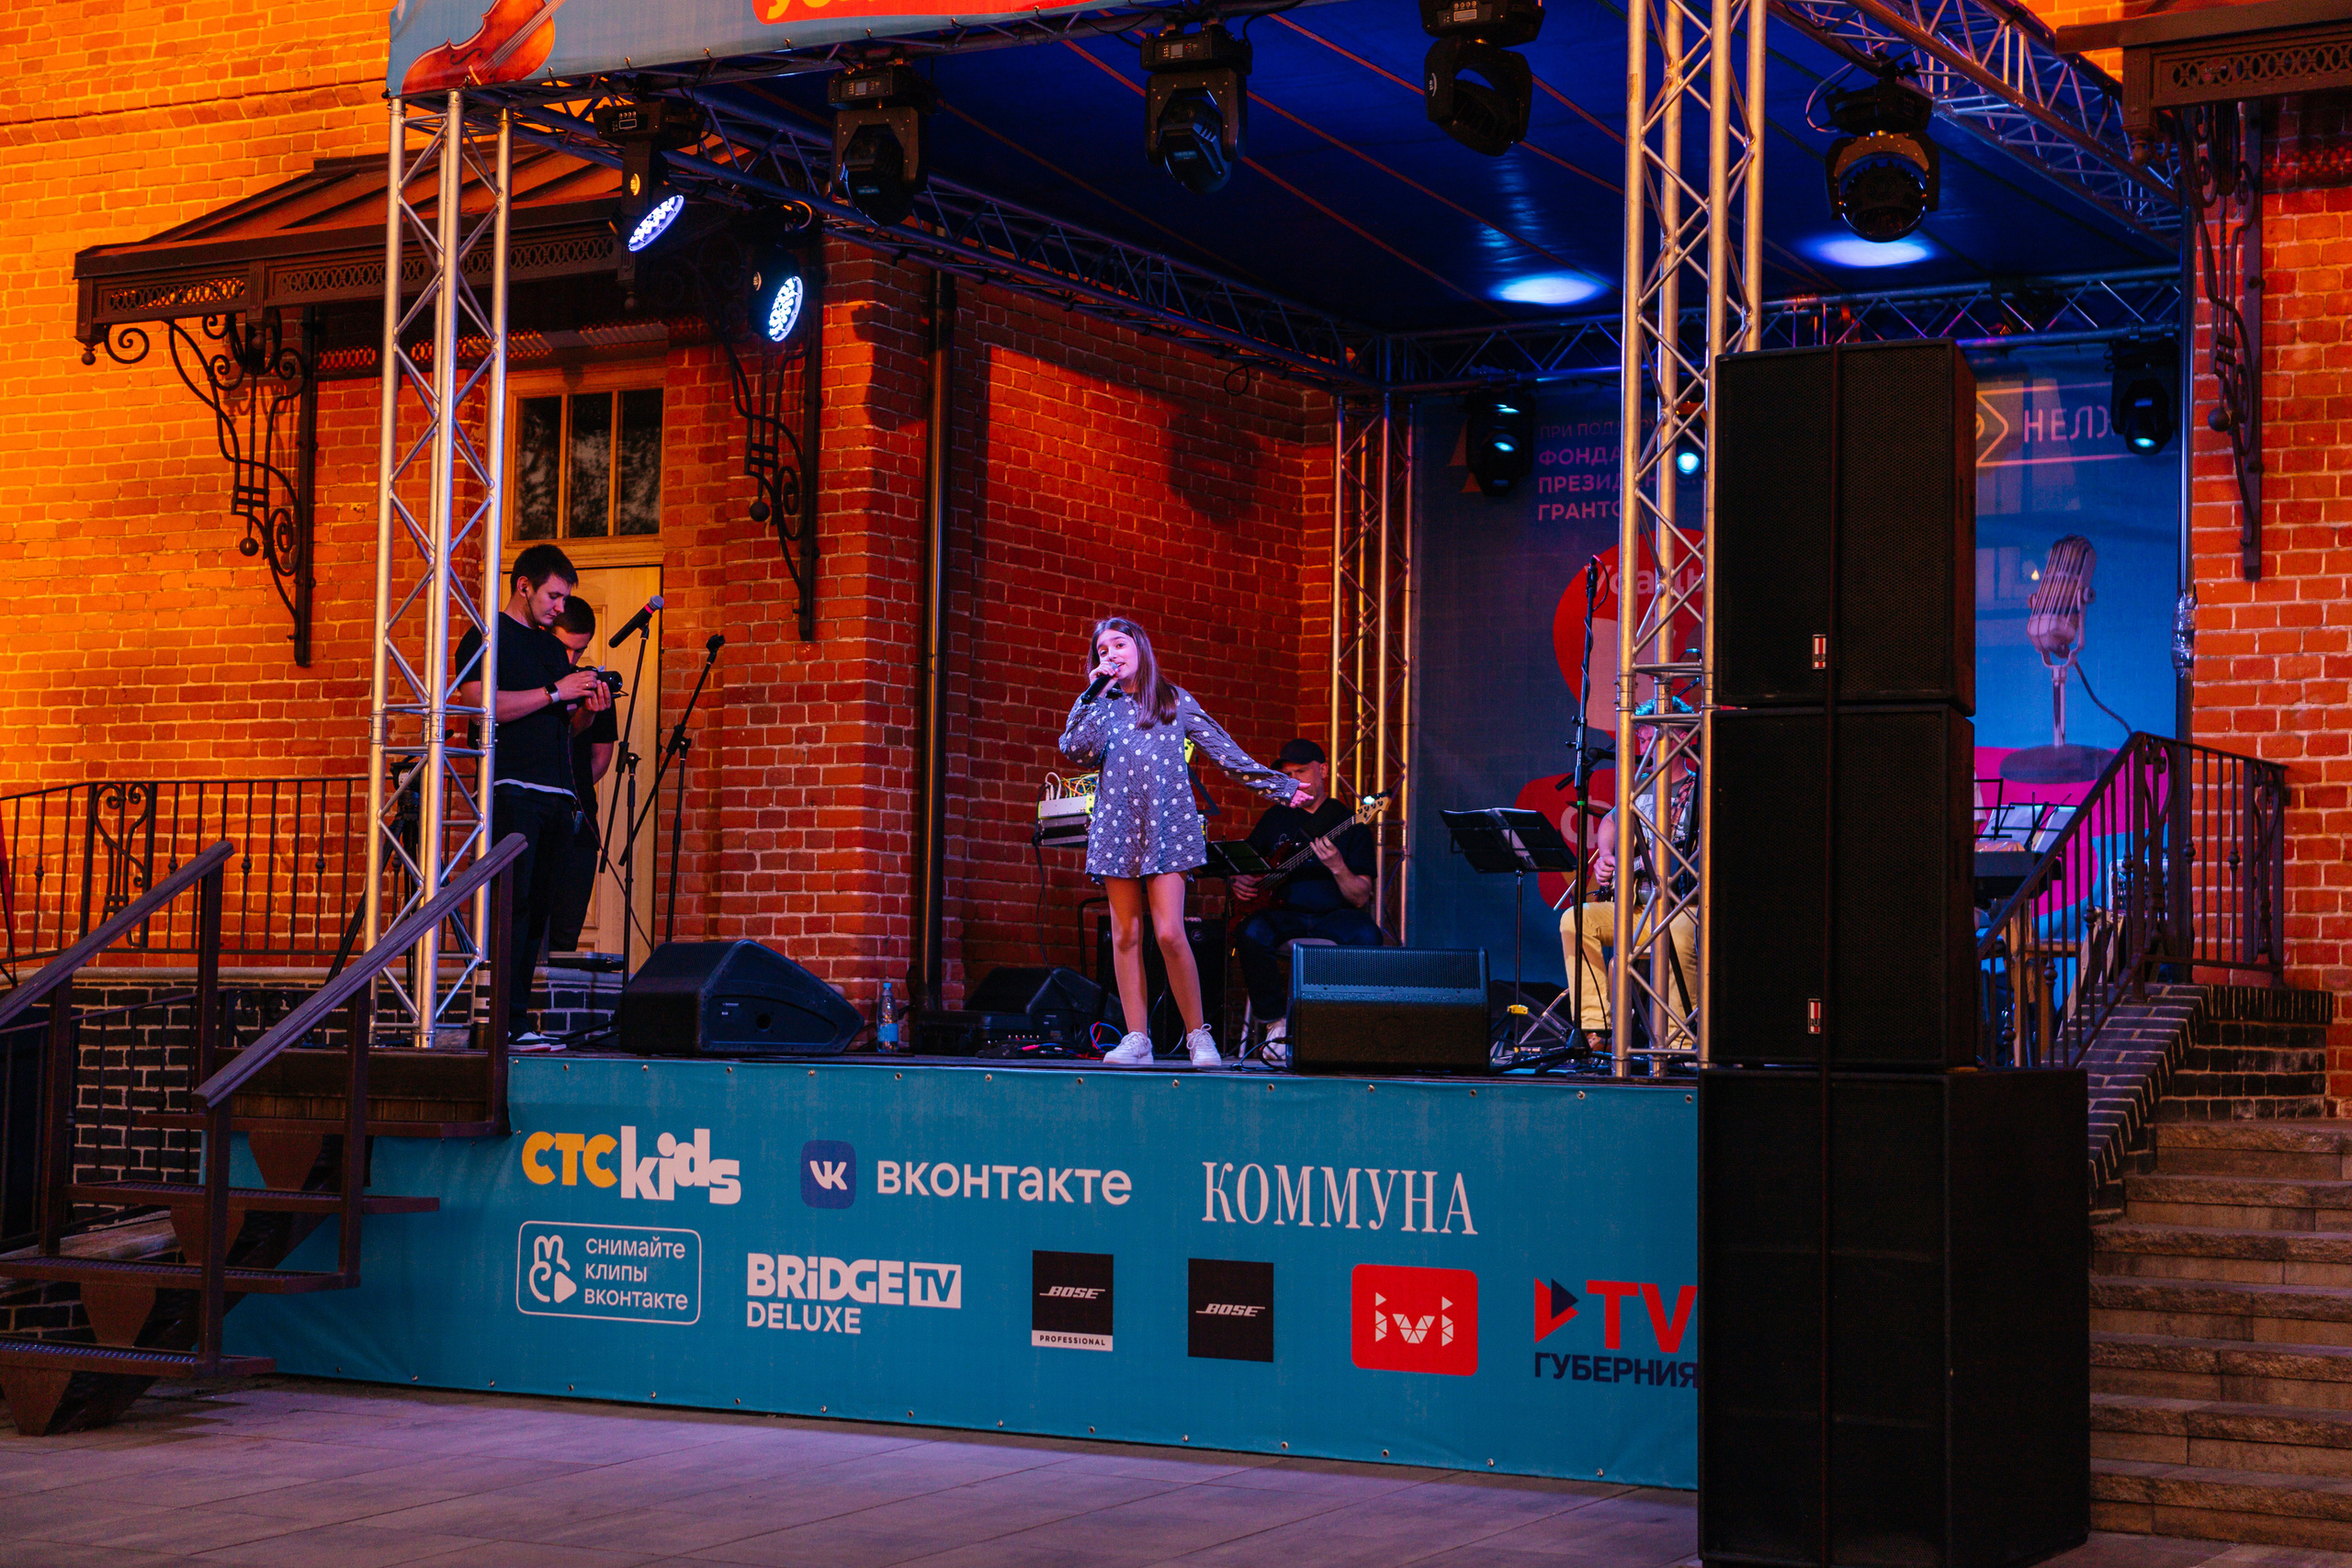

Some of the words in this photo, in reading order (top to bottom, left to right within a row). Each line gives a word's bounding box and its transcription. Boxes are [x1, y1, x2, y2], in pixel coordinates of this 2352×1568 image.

[1202, 1161, 1478, 1235] КОММУНА
[1039, 1285, 1106, 1300] BOSE
[747, 1307, 861, 1335] DELUXE
[1195, 1303, 1266, 1317] BOSE
[1586, 1280, 1698, 1353] TV
[1039, 1334, 1106, 1347] PROFESSIONAL
[1534, 1352, 1698, 1389] ГУБЕРНИЯ
